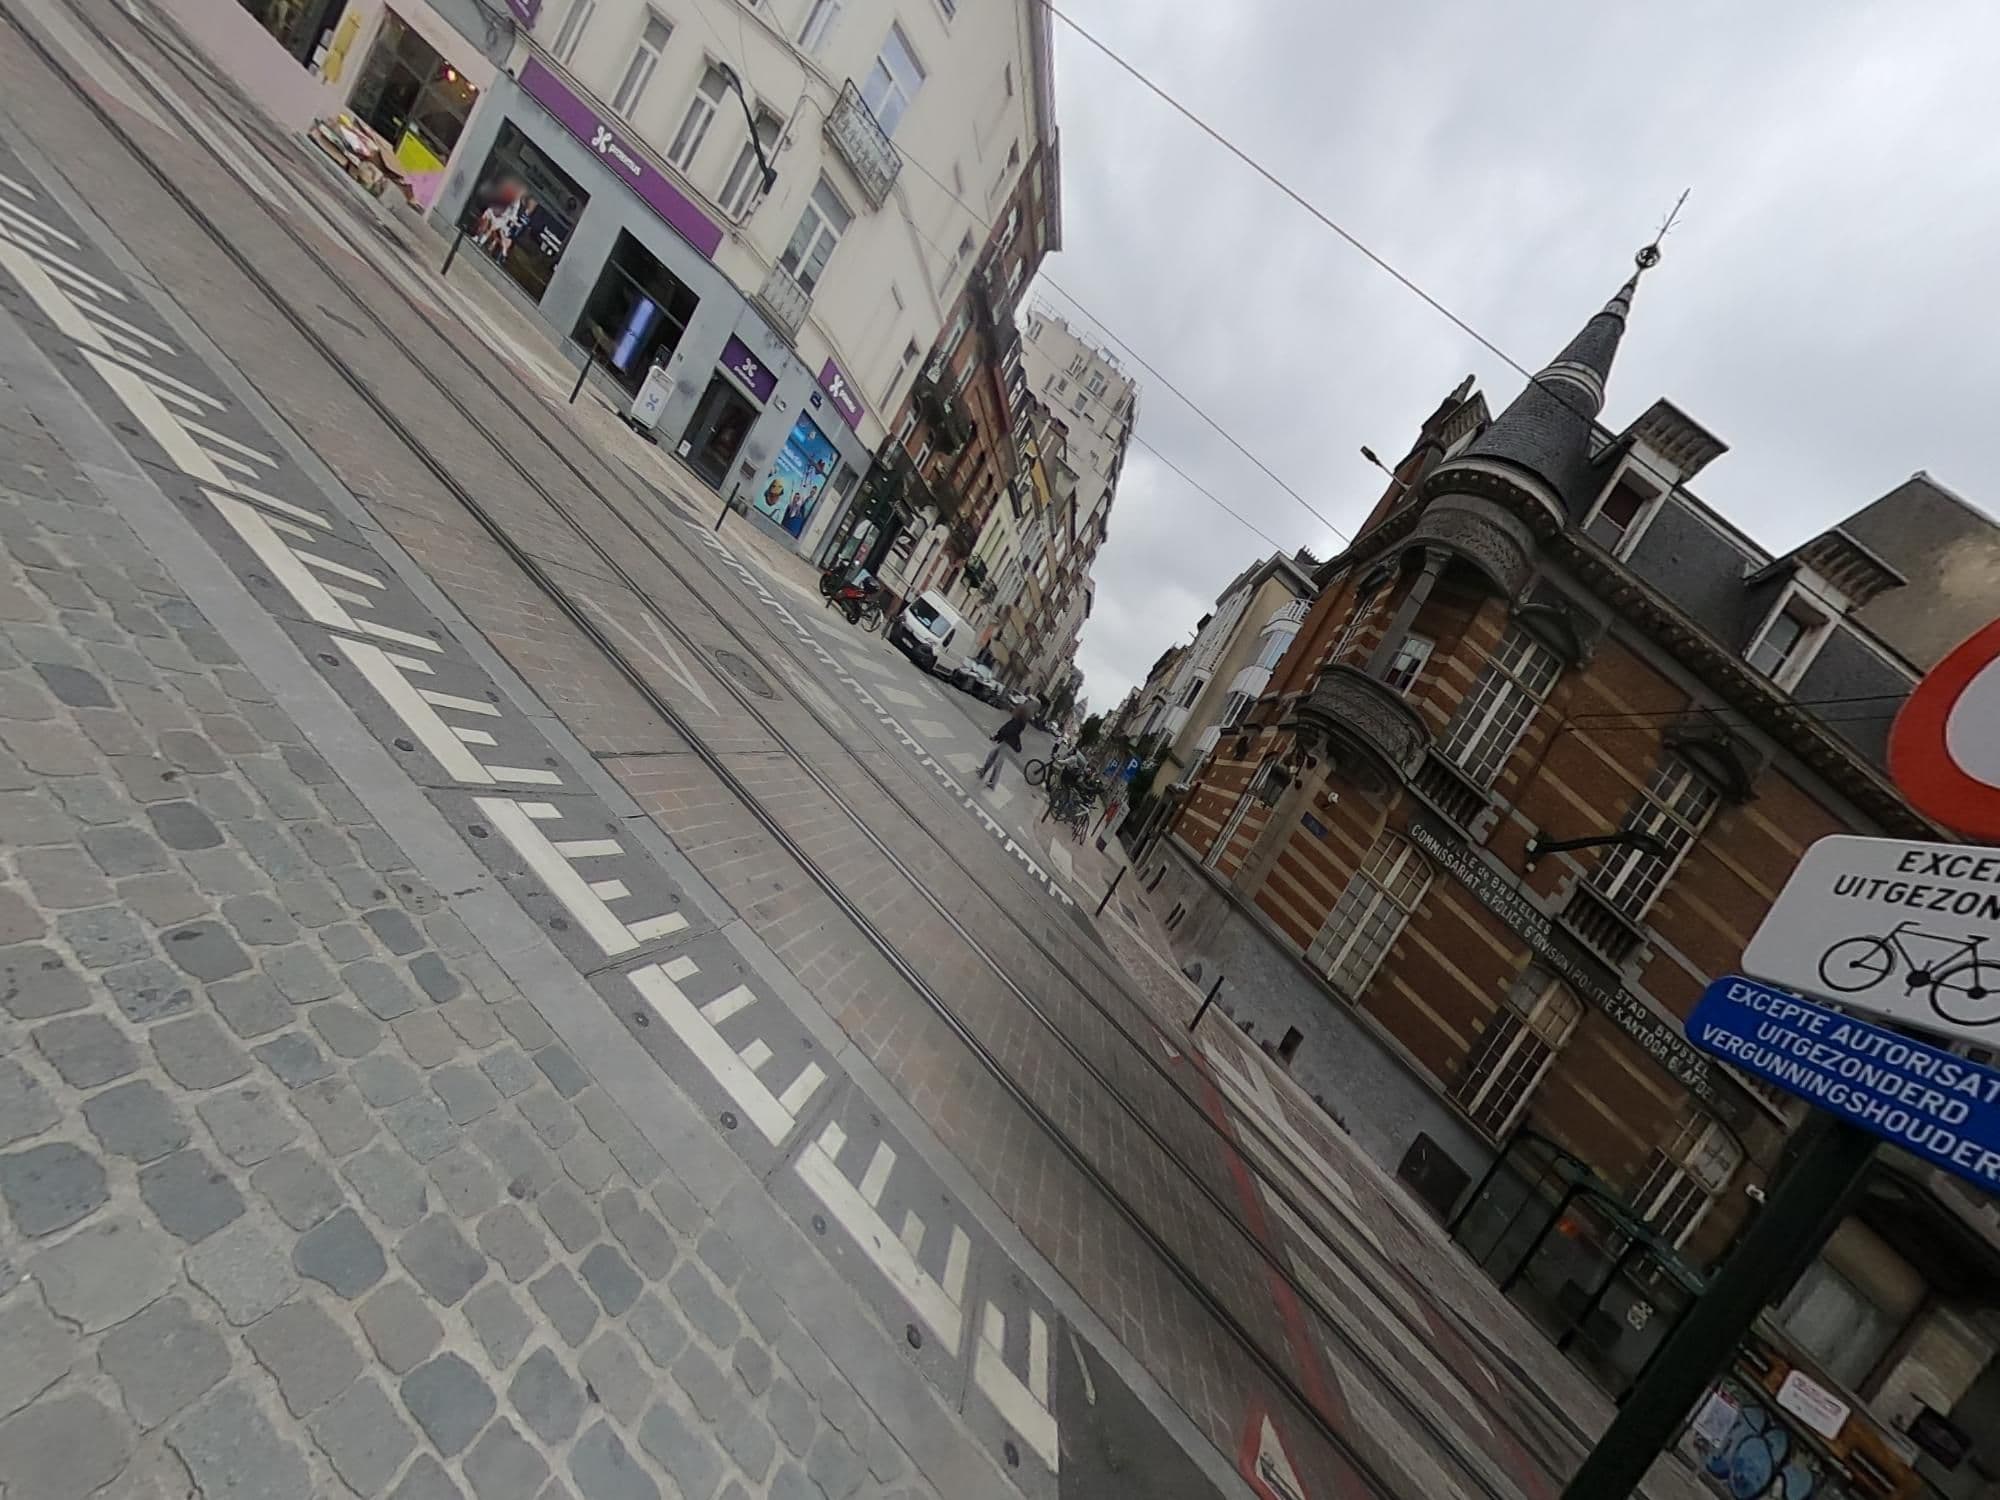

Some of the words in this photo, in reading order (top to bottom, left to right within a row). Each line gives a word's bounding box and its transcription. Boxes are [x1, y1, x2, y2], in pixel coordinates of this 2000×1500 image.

[1410, 824, 1481, 889] COMMISSARIAT
[1479, 887, 1491, 901] de
[1489, 895, 1524, 929] POLICE
[1478, 866, 1490, 880] de
[1490, 876, 1552, 935] BRUXELLES
[1896, 850, 2000, 884] EXCE
[1615, 988, 1646, 1020] STAD
[1654, 1024, 1709, 1079] BRUSSEL
[1726, 983, 1831, 1035] EXCEPTE
[1702, 1023, 2000, 1182] VERGUNNINGSHOUDER
[1756, 1021, 1969, 1124] UITGEZONDERD
